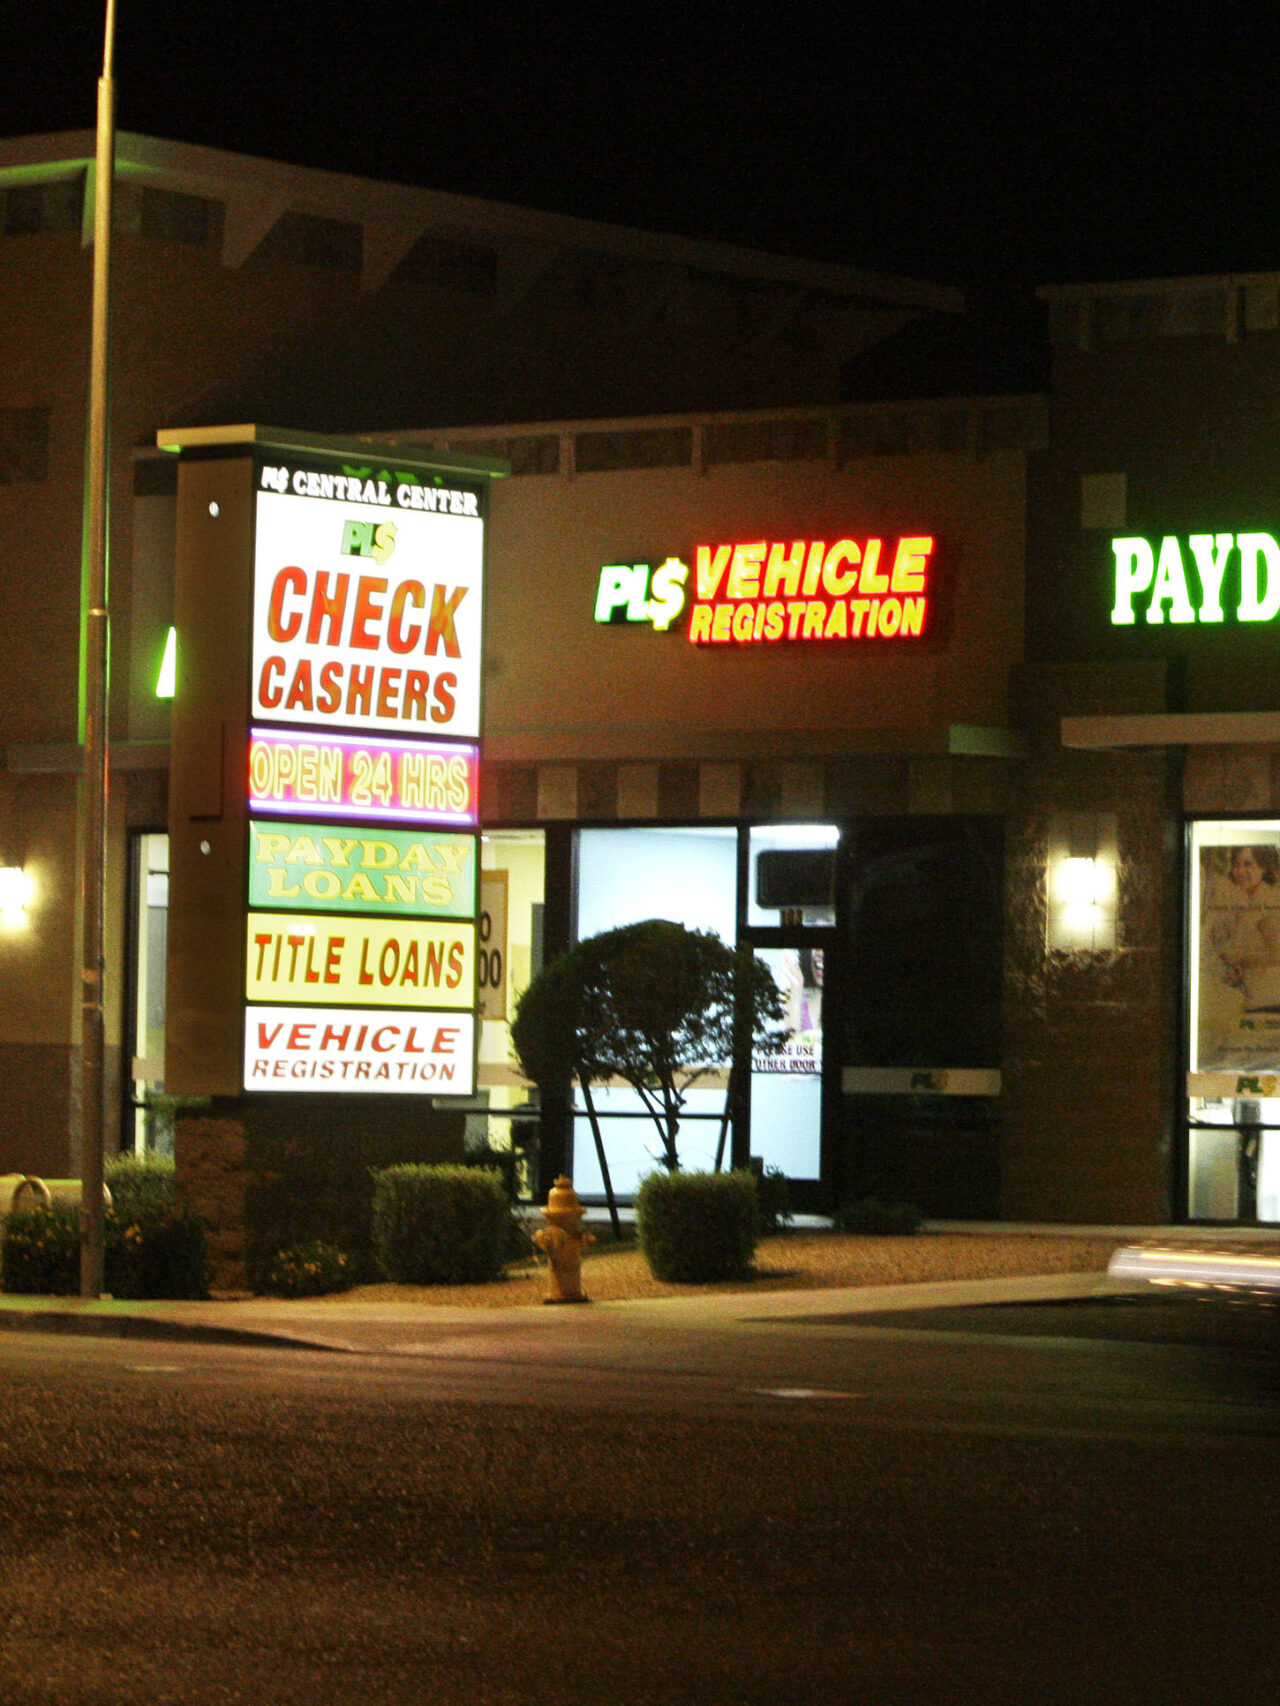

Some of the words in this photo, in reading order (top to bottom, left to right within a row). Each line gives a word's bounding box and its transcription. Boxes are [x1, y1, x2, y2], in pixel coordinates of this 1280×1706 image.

[293, 471, 391, 505] CENTRAL
[397, 484, 478, 517] CENTER
[696, 536, 934, 600] VEHICLE
[268, 566, 470, 658] CHECK
[689, 597, 926, 643] REGISTRATION
[258, 656, 457, 723] CASHERS
[250, 740, 343, 802] OPEN
[353, 751, 392, 807] 24
[401, 752, 469, 812] HRS
[255, 834, 472, 874] PAYDAY
[267, 868, 455, 906] LOANS
[255, 933, 345, 984] TITLE
[359, 937, 464, 989] LOANS
[257, 1022, 460, 1053] VEHICLE
[797, 1044, 814, 1056] USE
[252, 1059, 456, 1081] REGISTRATION
